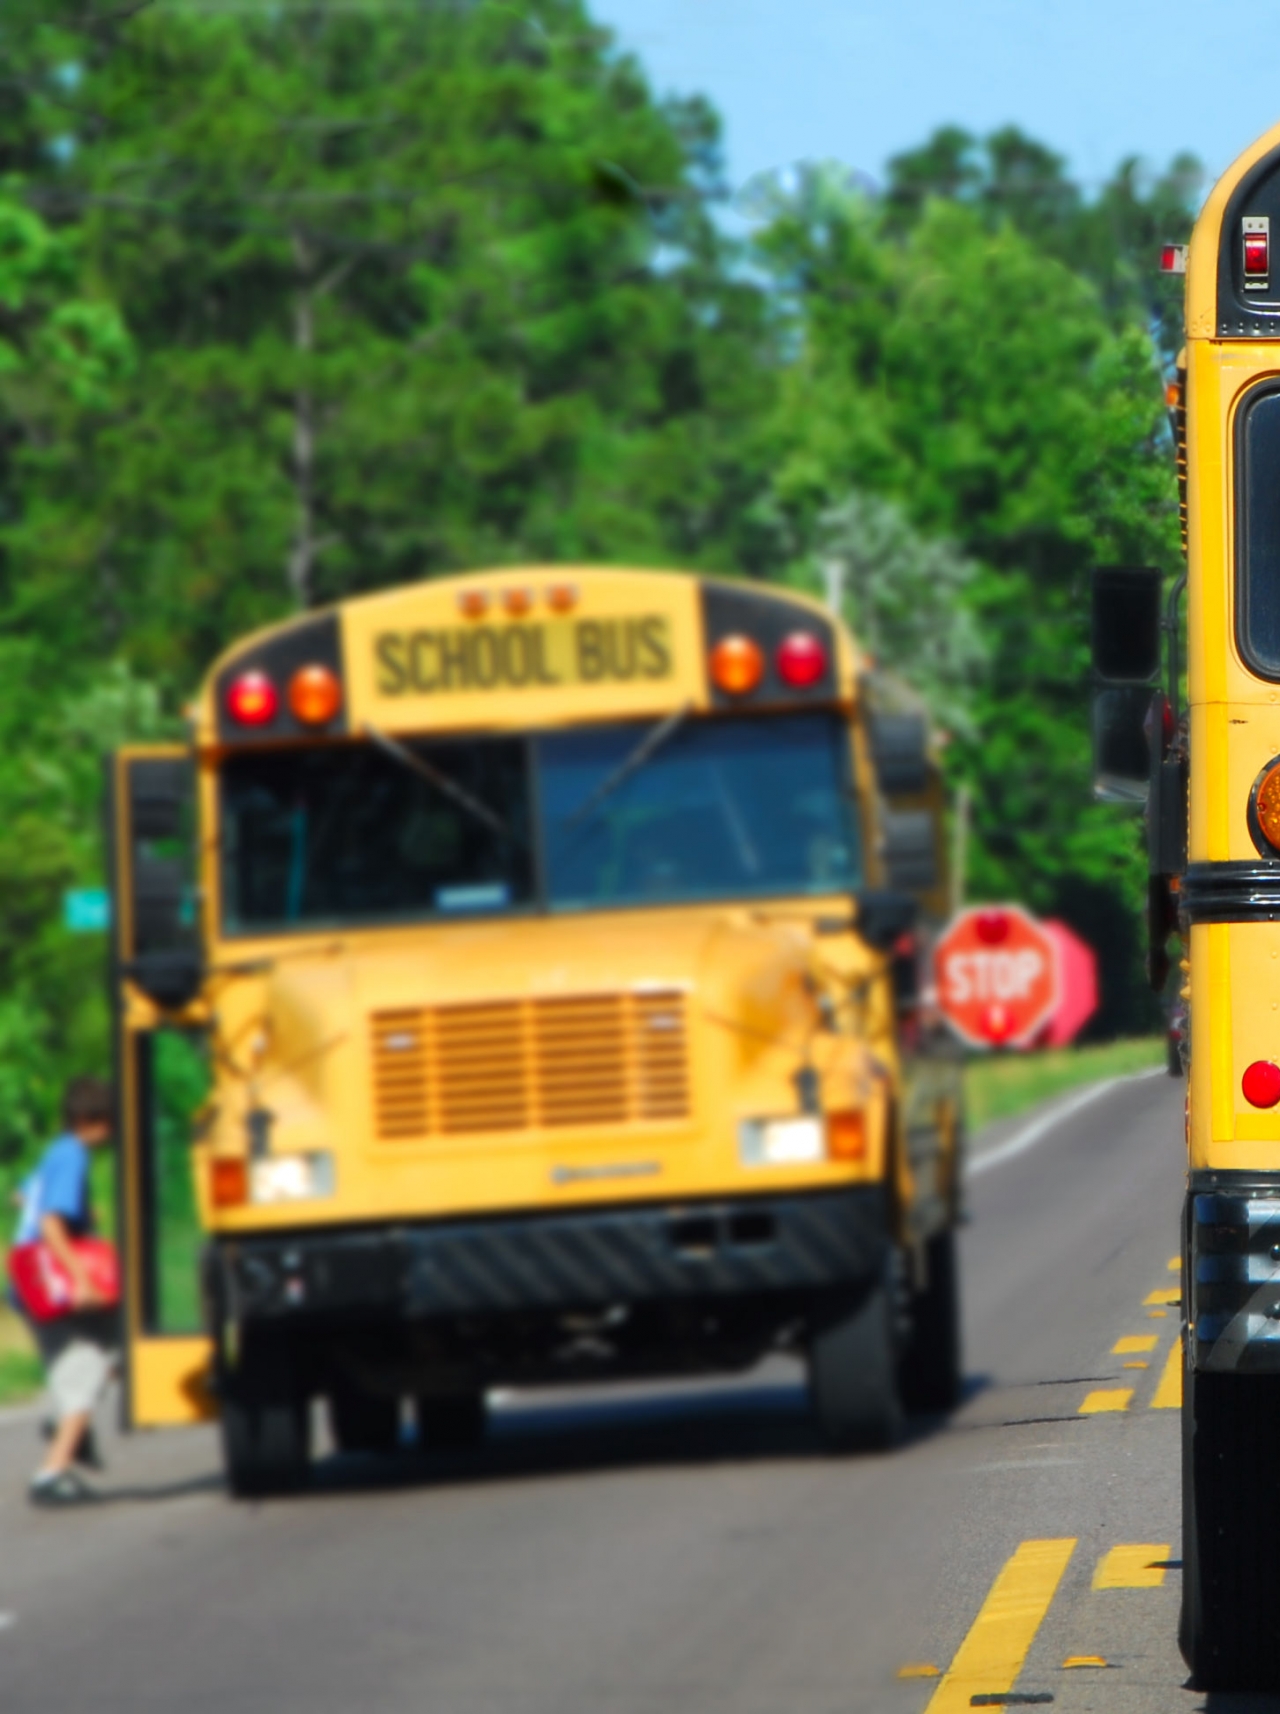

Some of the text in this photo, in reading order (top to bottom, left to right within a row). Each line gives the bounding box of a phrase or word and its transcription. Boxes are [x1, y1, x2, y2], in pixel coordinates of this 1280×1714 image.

[374, 614, 673, 697] SCHOOL BUS
[946, 949, 1043, 1004] STOP
